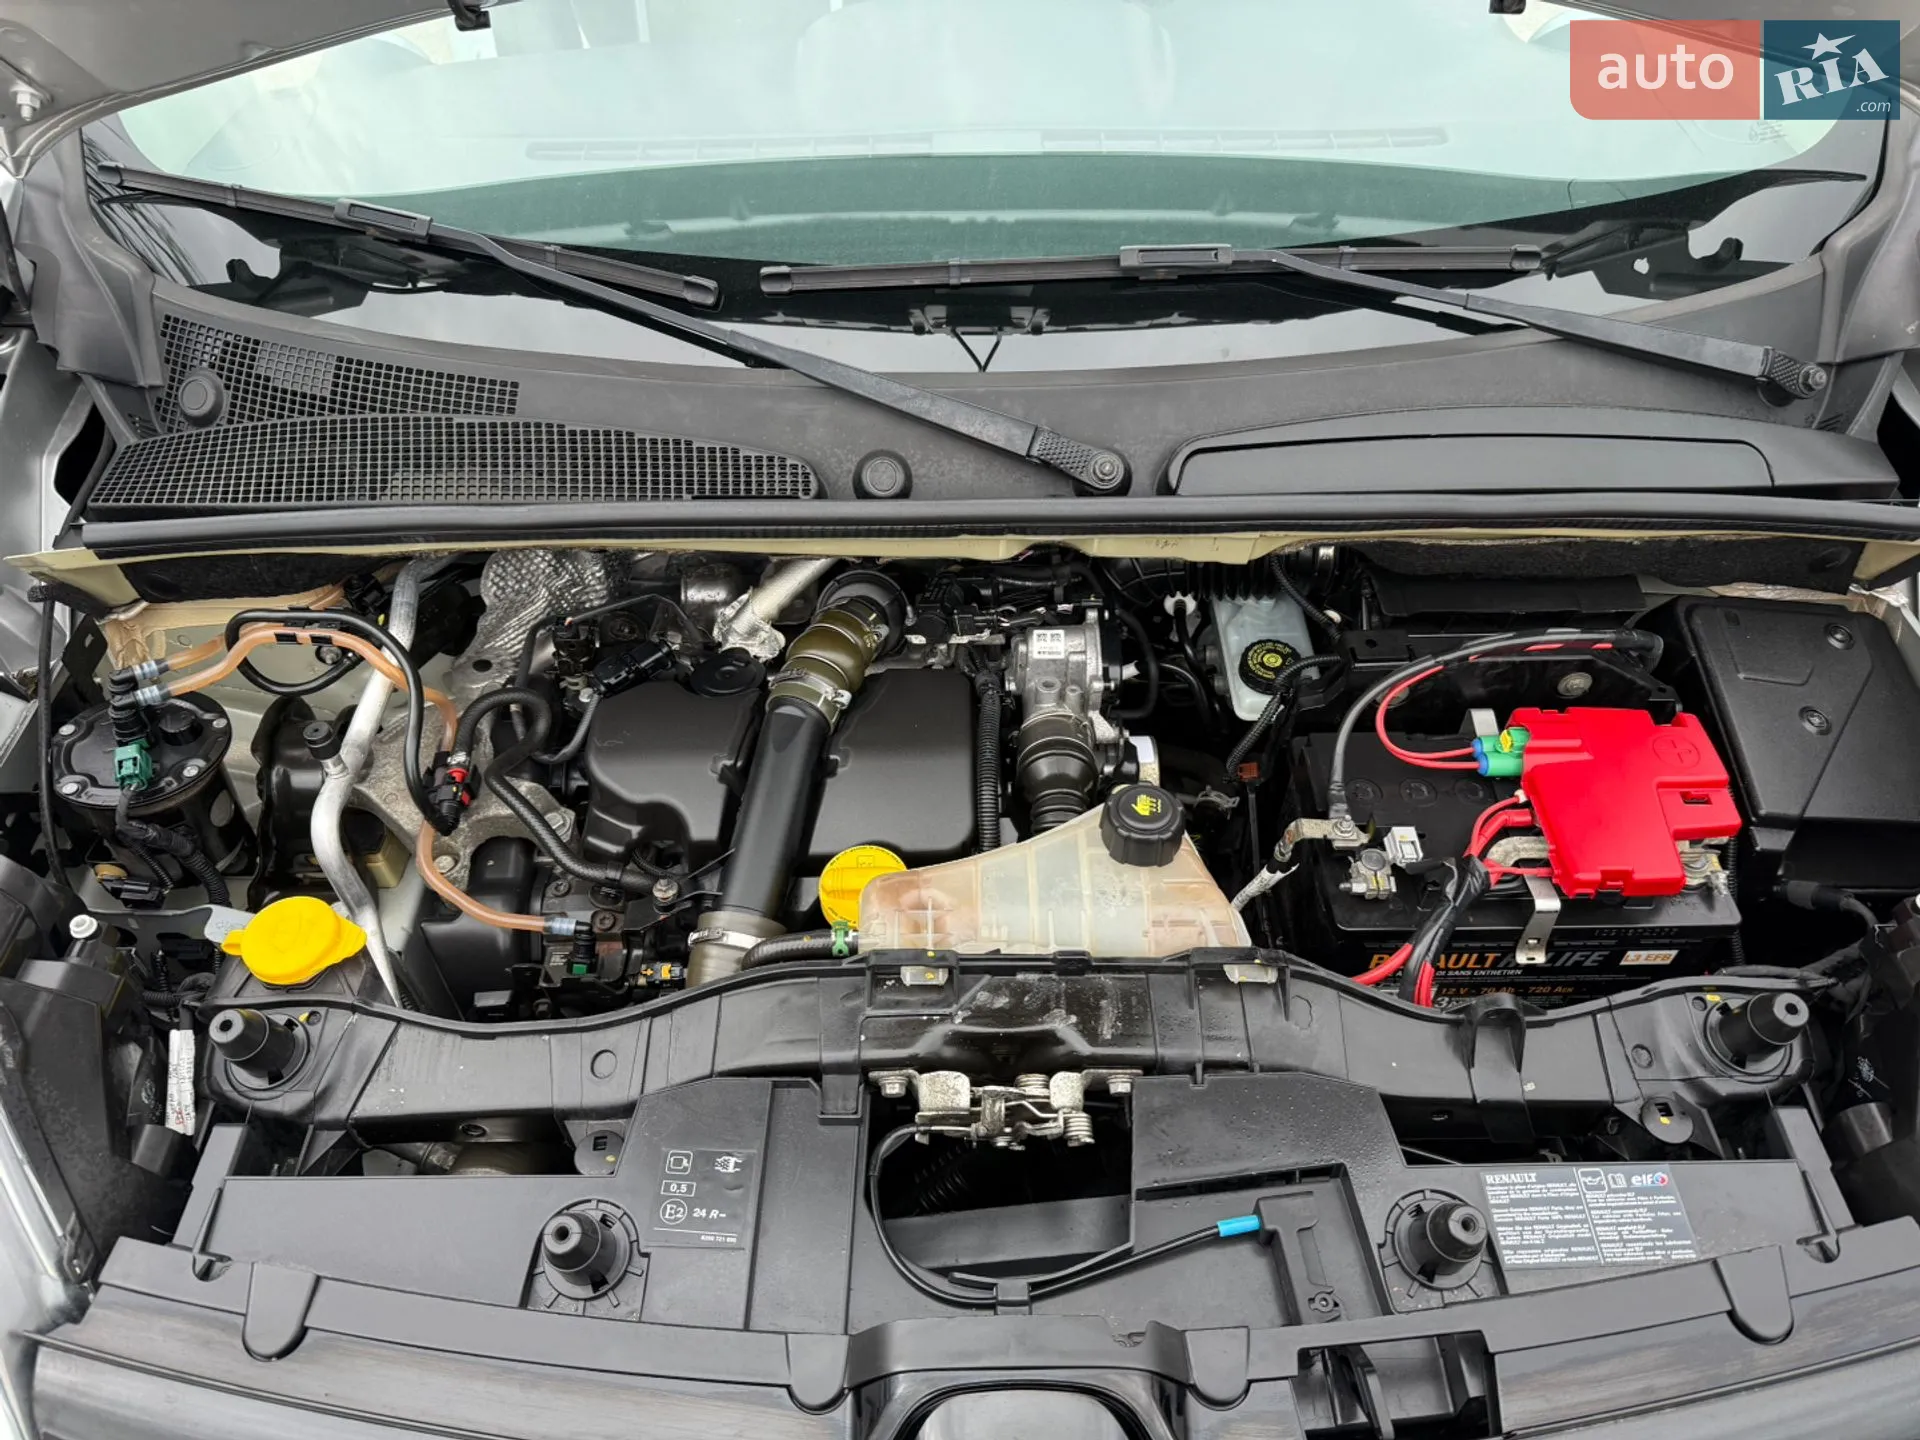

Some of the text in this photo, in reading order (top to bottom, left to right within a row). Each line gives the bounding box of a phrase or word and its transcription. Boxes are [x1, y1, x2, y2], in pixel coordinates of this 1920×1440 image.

[1369, 953, 1501, 969] RAULT
[1645, 953, 1673, 962] EFB
[1528, 986, 1550, 994] 720
[1485, 1172, 1537, 1184] RENAULT
[664, 1203, 684, 1219] E2
[692, 1208, 707, 1218] 24
